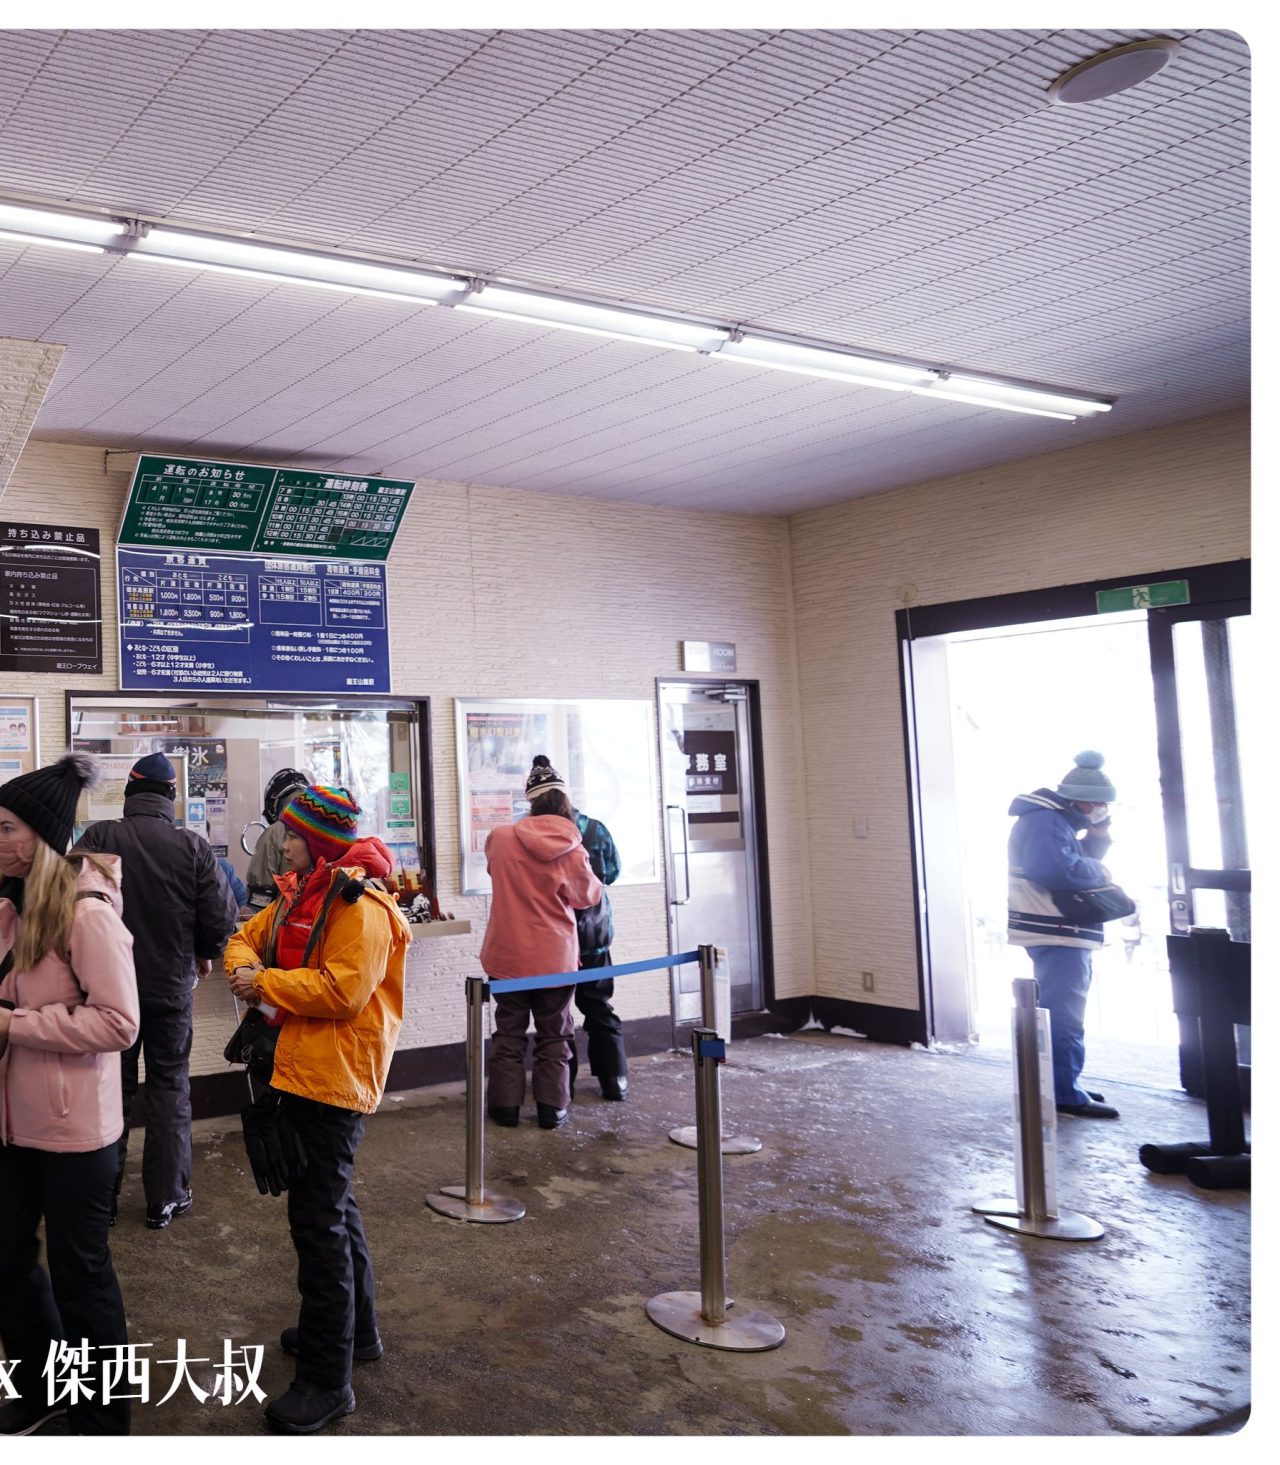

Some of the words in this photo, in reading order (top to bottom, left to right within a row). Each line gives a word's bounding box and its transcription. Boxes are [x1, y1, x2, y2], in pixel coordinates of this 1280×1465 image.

[163, 464, 246, 480] 運転のお知らせ
[8, 528, 85, 543] 持ち込み禁止品
[686, 753, 727, 772] 務室
